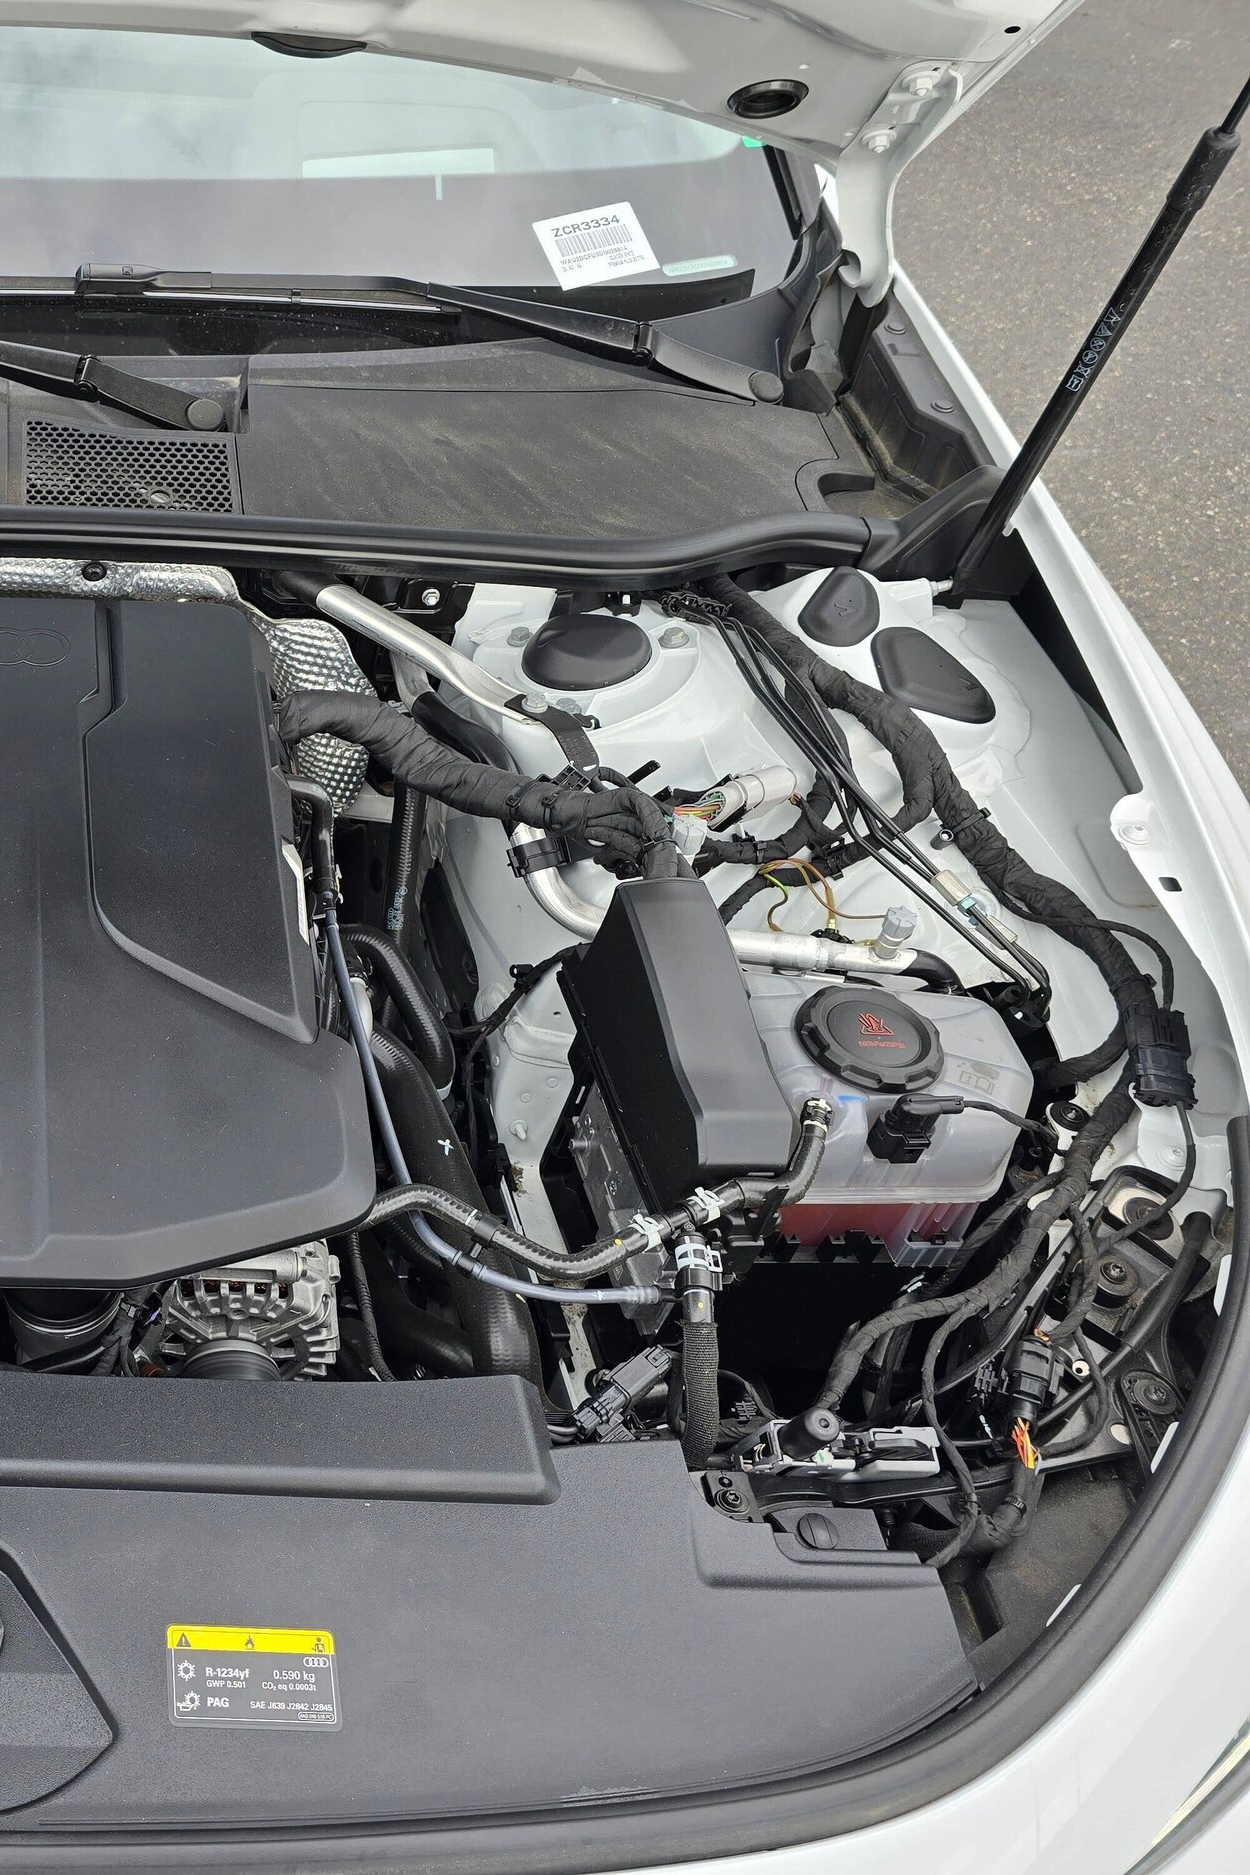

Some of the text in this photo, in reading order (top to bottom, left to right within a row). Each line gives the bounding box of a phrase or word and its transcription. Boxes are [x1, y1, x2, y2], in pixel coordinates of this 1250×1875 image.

[551, 215, 620, 237] ZCR3334
[205, 1667, 250, 1680] R-1234yf
[273, 1670, 315, 1682] 0.590 kg
[206, 1680, 246, 1688] GWP 0.501
[278, 1683, 288, 1691] eq
[288, 1683, 317, 1691] 0.0003t
[206, 1697, 230, 1708] PAG
[250, 1701, 333, 1711] SAE J639 J2842 J2845
